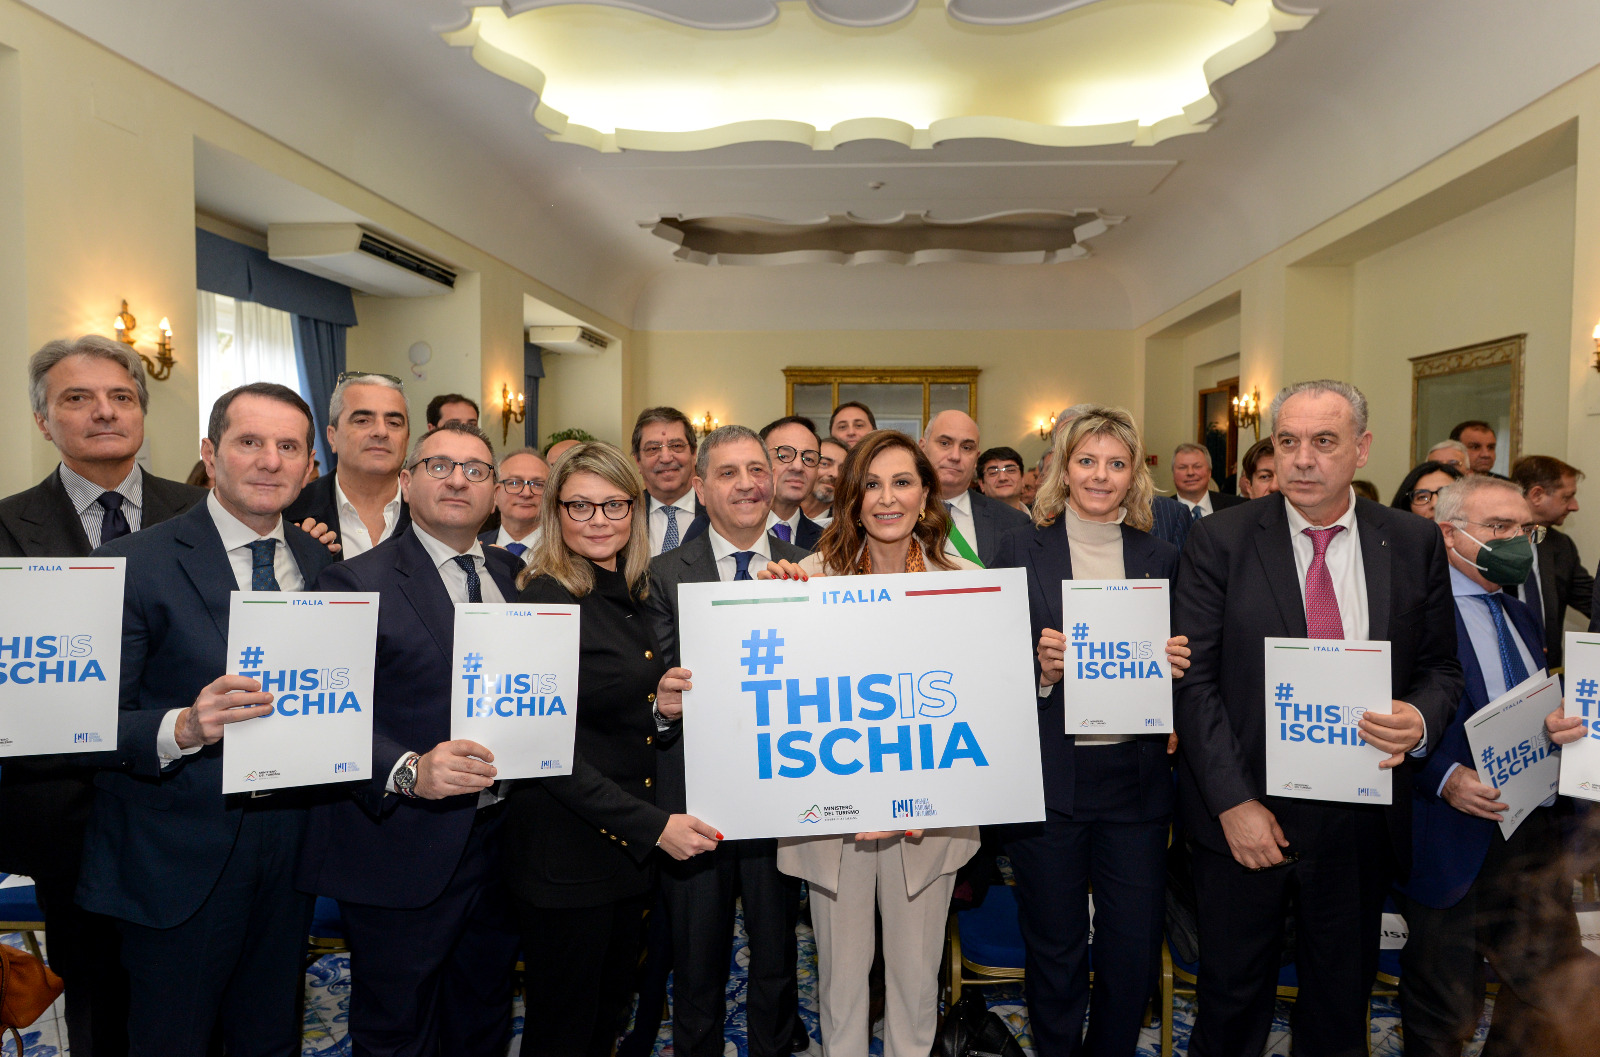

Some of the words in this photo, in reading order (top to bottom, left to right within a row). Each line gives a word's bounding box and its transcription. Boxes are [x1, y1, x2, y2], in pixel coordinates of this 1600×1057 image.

[823, 588, 892, 605] ITALIA
[506, 609, 532, 617] ITALIA
[1072, 623, 1089, 640] #
[239, 646, 264, 669] #
[740, 629, 784, 675] #
[1072, 641, 1153, 660] THISIS
[463, 652, 483, 672] #
[1077, 661, 1163, 680] ISCHIA
[462, 673, 557, 695] THISIS
[1275, 683, 1294, 701] #
[1576, 678, 1598, 697] #
[467, 696, 567, 718] ISCHIA
[741, 670, 957, 727] THISIS
[1502, 699, 1523, 712] ITALIA
[1280, 722, 1367, 747] ISCHI
[757, 722, 989, 780] ISCHIA
[1481, 746, 1494, 763] #
[892, 799, 914, 818] ENIT
